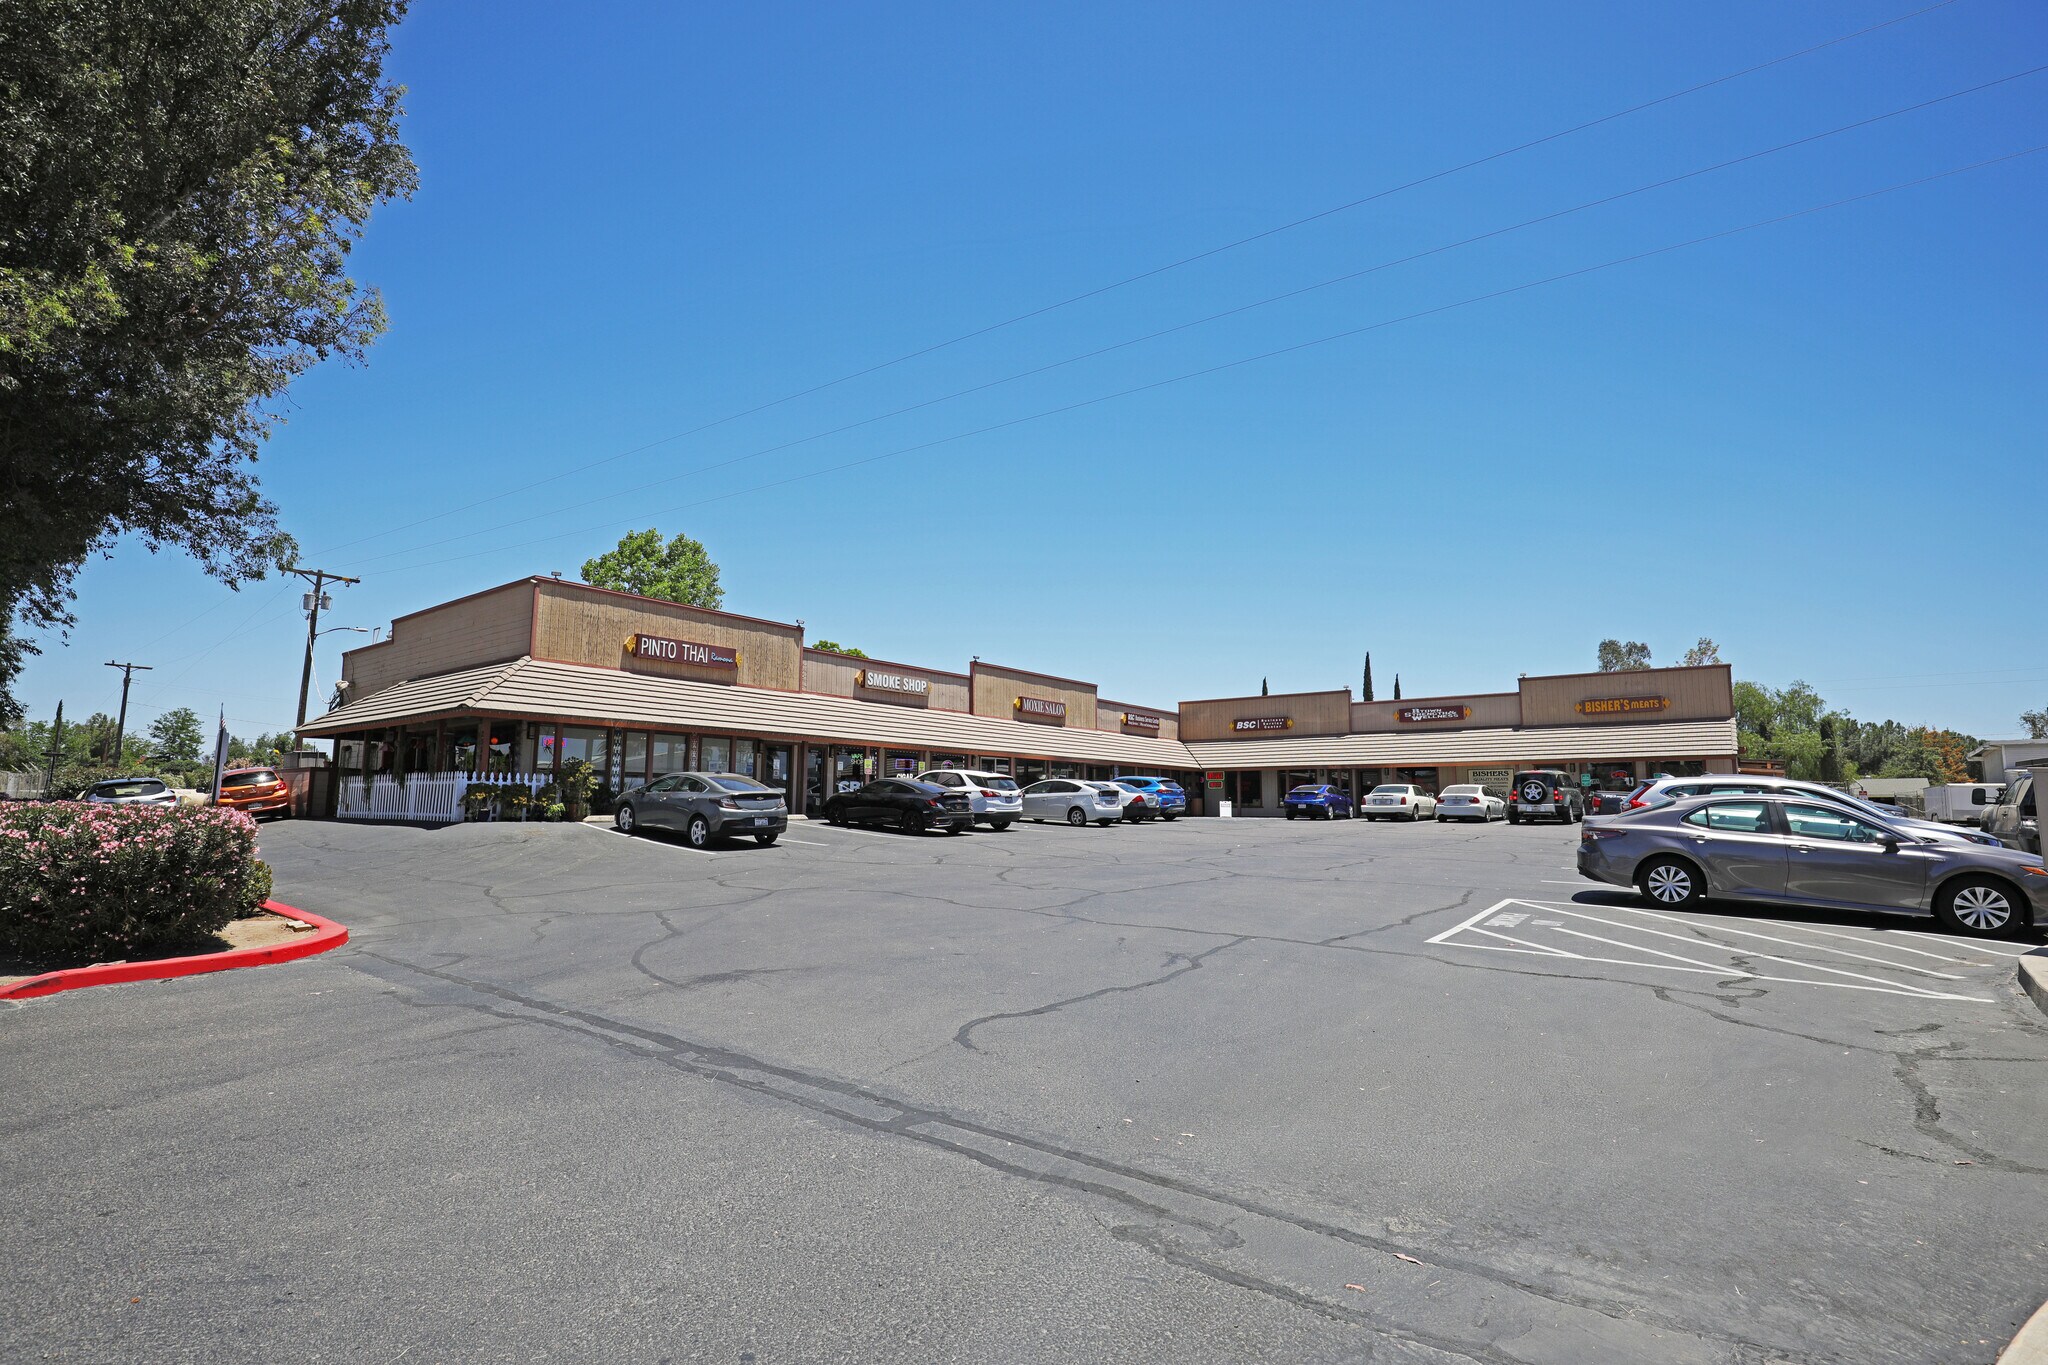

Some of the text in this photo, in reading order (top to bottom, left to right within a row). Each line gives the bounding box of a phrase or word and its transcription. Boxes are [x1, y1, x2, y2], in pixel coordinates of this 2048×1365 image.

[641, 637, 677, 659] PINTO
[682, 643, 709, 664] THAI
[867, 672, 927, 693] SMOKE SHOP
[1023, 698, 1065, 716] MOXIE SALON
[1585, 699, 1630, 713] BISHER'S
[1236, 720, 1257, 730] BSC
